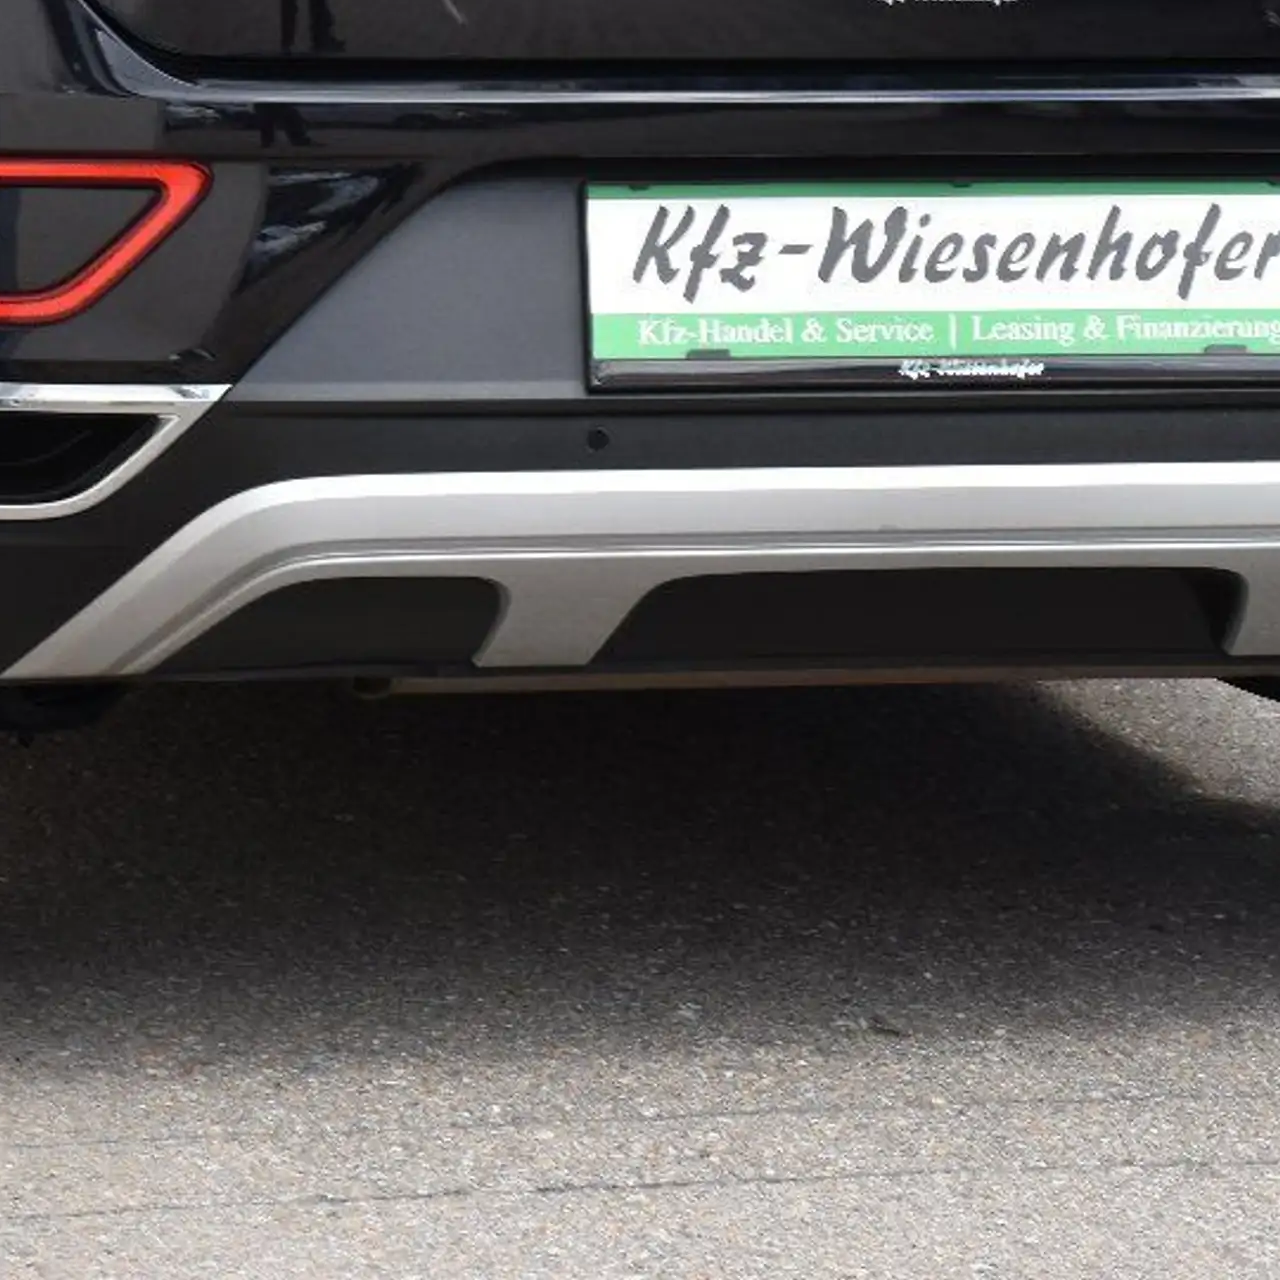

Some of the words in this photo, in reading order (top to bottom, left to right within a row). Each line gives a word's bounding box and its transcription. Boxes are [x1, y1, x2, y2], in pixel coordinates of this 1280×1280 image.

[638, 318, 794, 346] Kfz-Handel
[801, 319, 827, 343] &
[836, 318, 934, 343] Service
[973, 315, 1075, 347] Leasing
[1083, 315, 1108, 340] &
